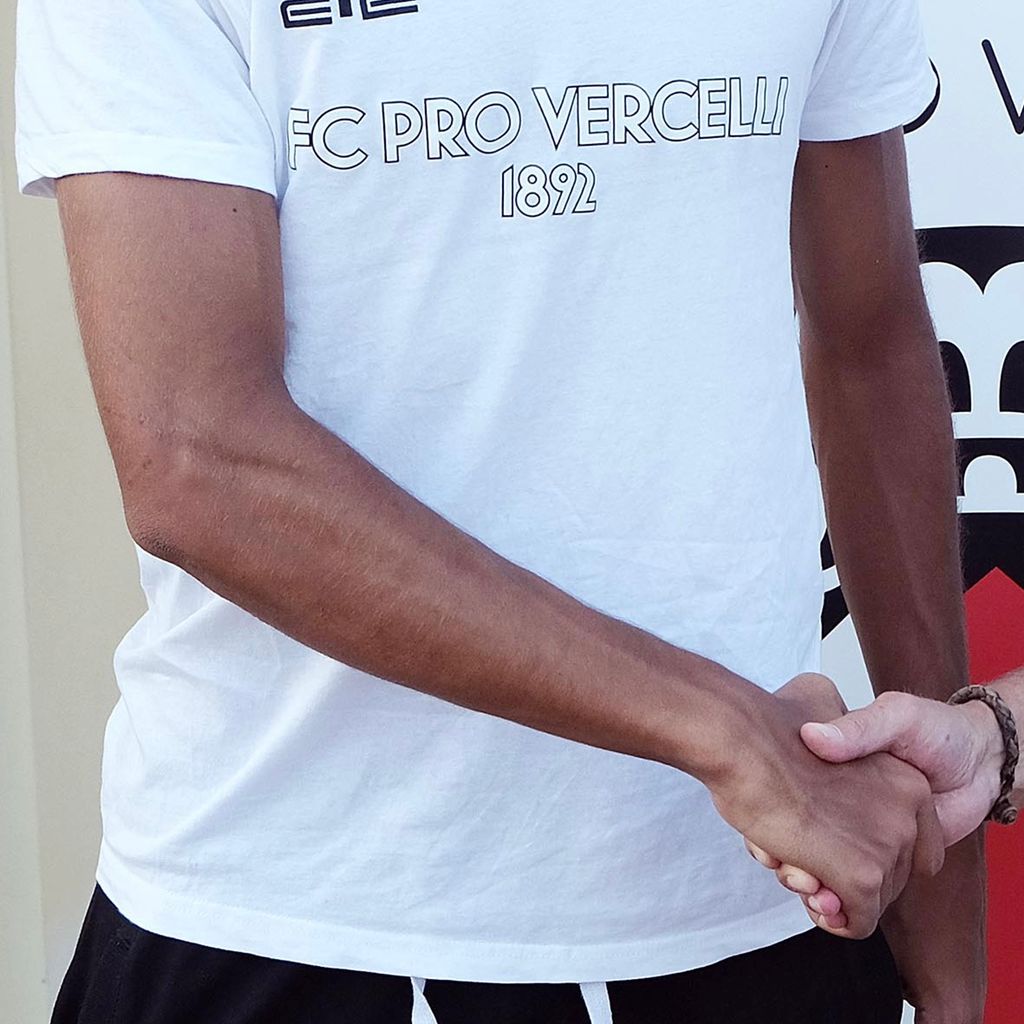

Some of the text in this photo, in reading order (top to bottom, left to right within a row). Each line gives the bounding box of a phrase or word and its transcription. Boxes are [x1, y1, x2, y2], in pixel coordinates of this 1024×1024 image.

[287, 76, 789, 170] FC PRO VERCELLI
[501, 163, 597, 218] 1892
